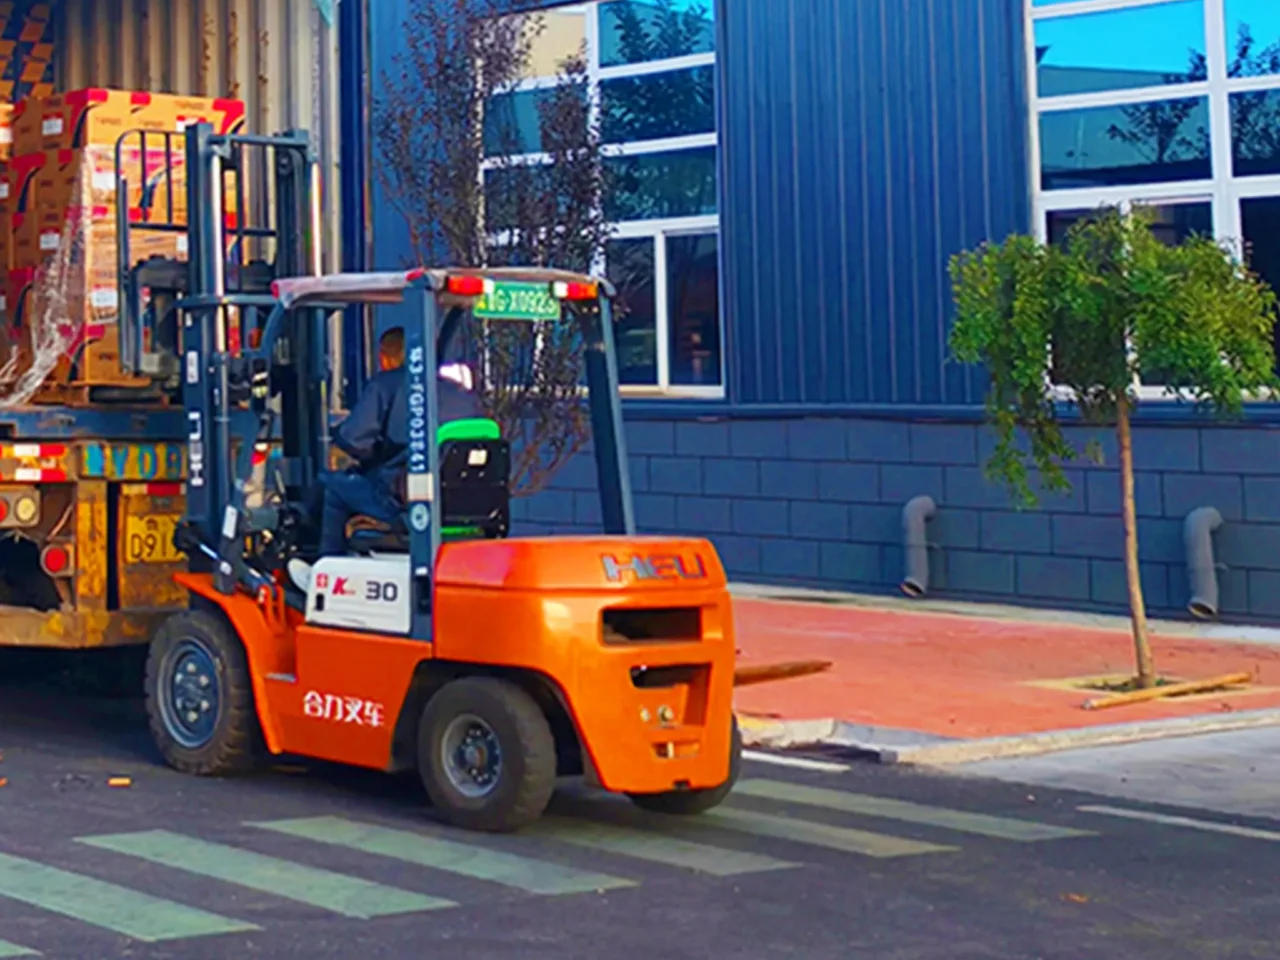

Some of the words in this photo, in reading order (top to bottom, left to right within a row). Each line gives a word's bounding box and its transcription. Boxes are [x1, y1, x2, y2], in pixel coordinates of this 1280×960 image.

[187, 412, 204, 486] HELI
[365, 580, 398, 602] 30
[303, 689, 384, 727] 合力叉车
